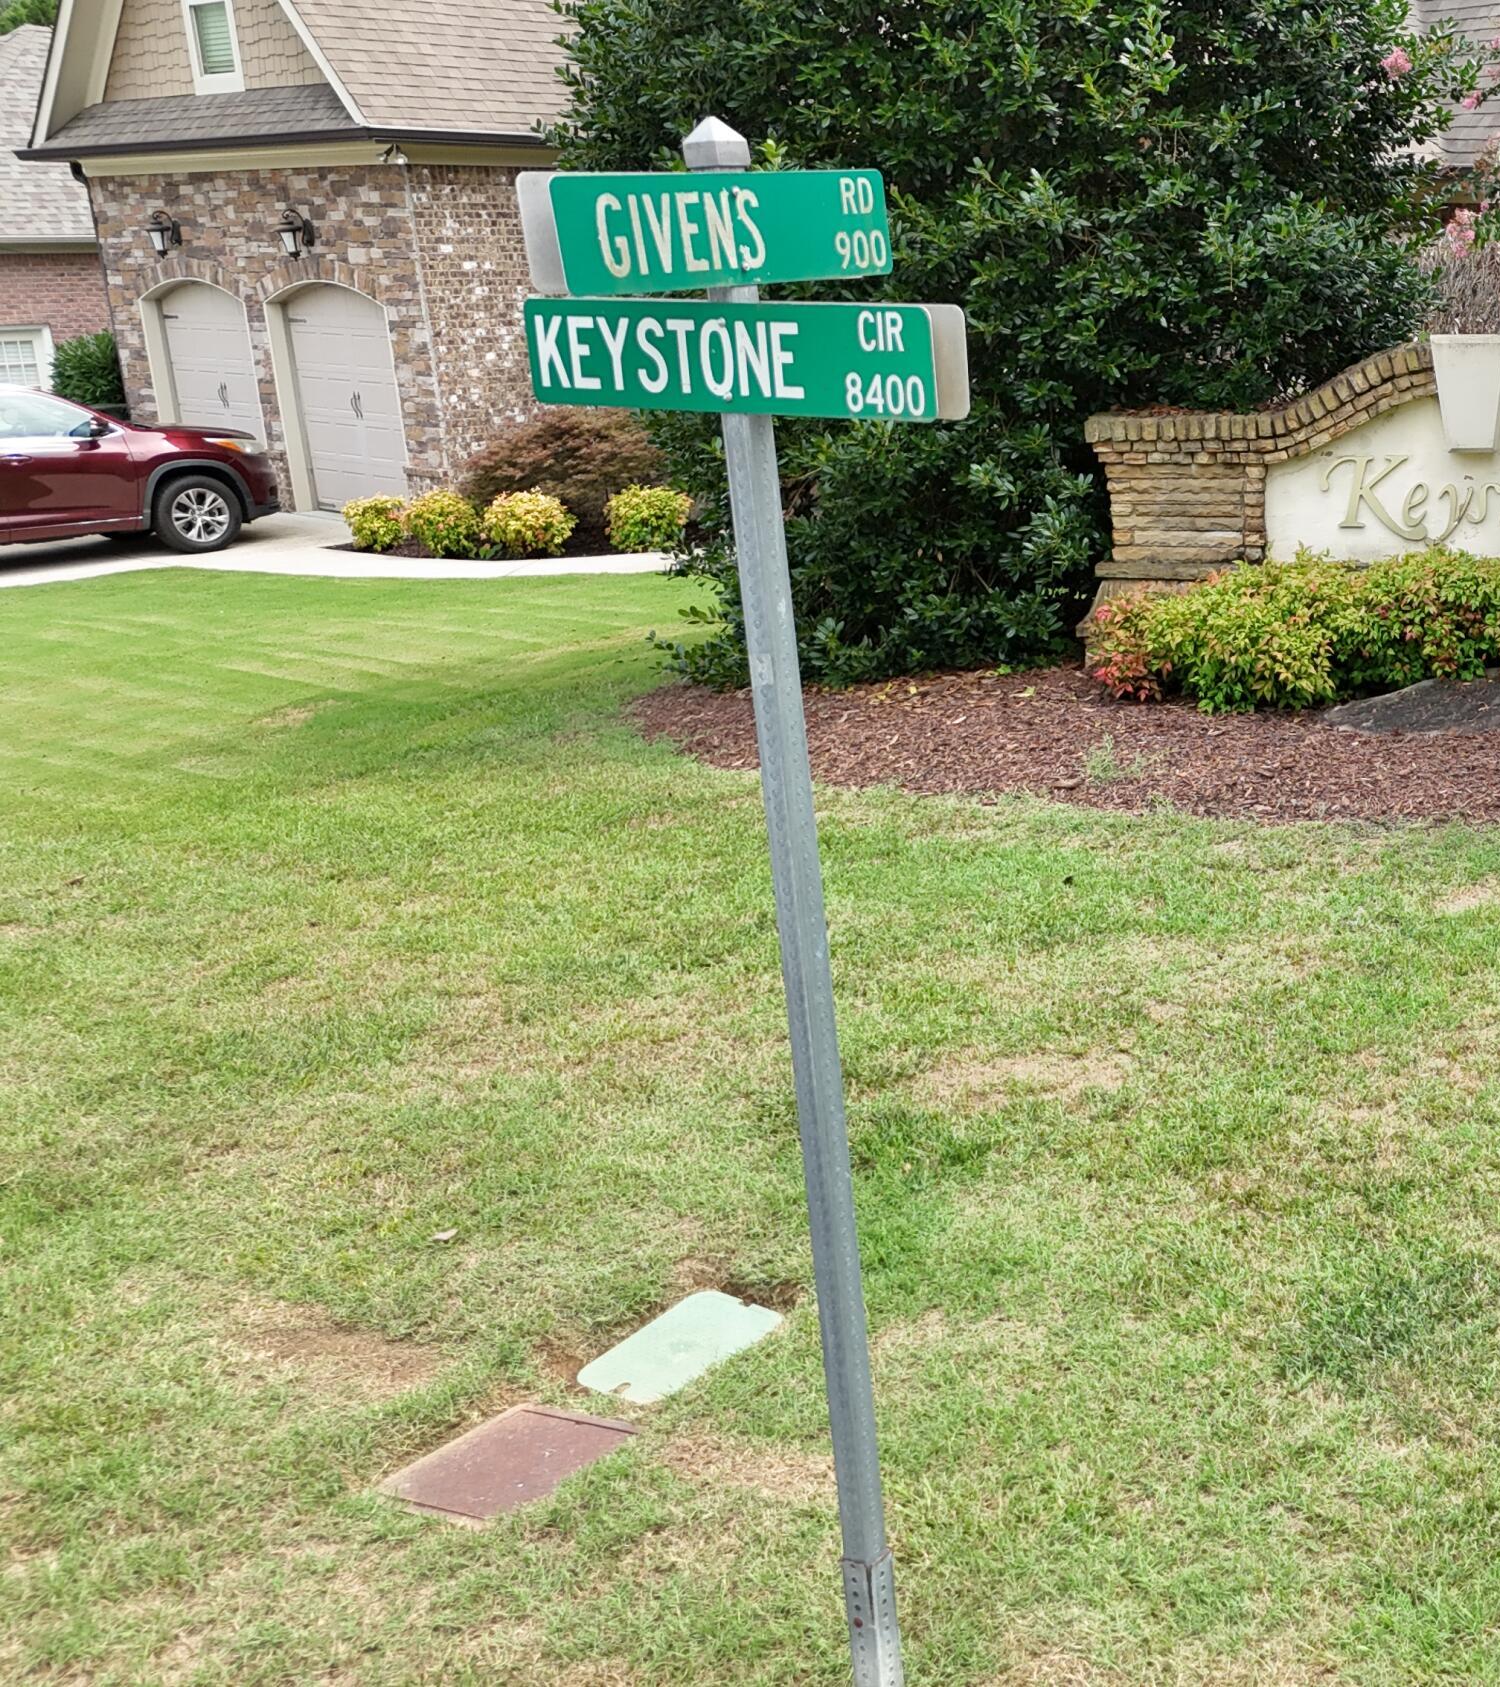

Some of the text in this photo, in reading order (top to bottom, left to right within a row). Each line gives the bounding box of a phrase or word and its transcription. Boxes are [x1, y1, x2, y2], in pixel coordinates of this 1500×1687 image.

[595, 176, 874, 278] GIVENS RD
[835, 230, 887, 269] 900
[534, 311, 904, 399] KEYSTONE CIR
[845, 372, 925, 416] 8400
